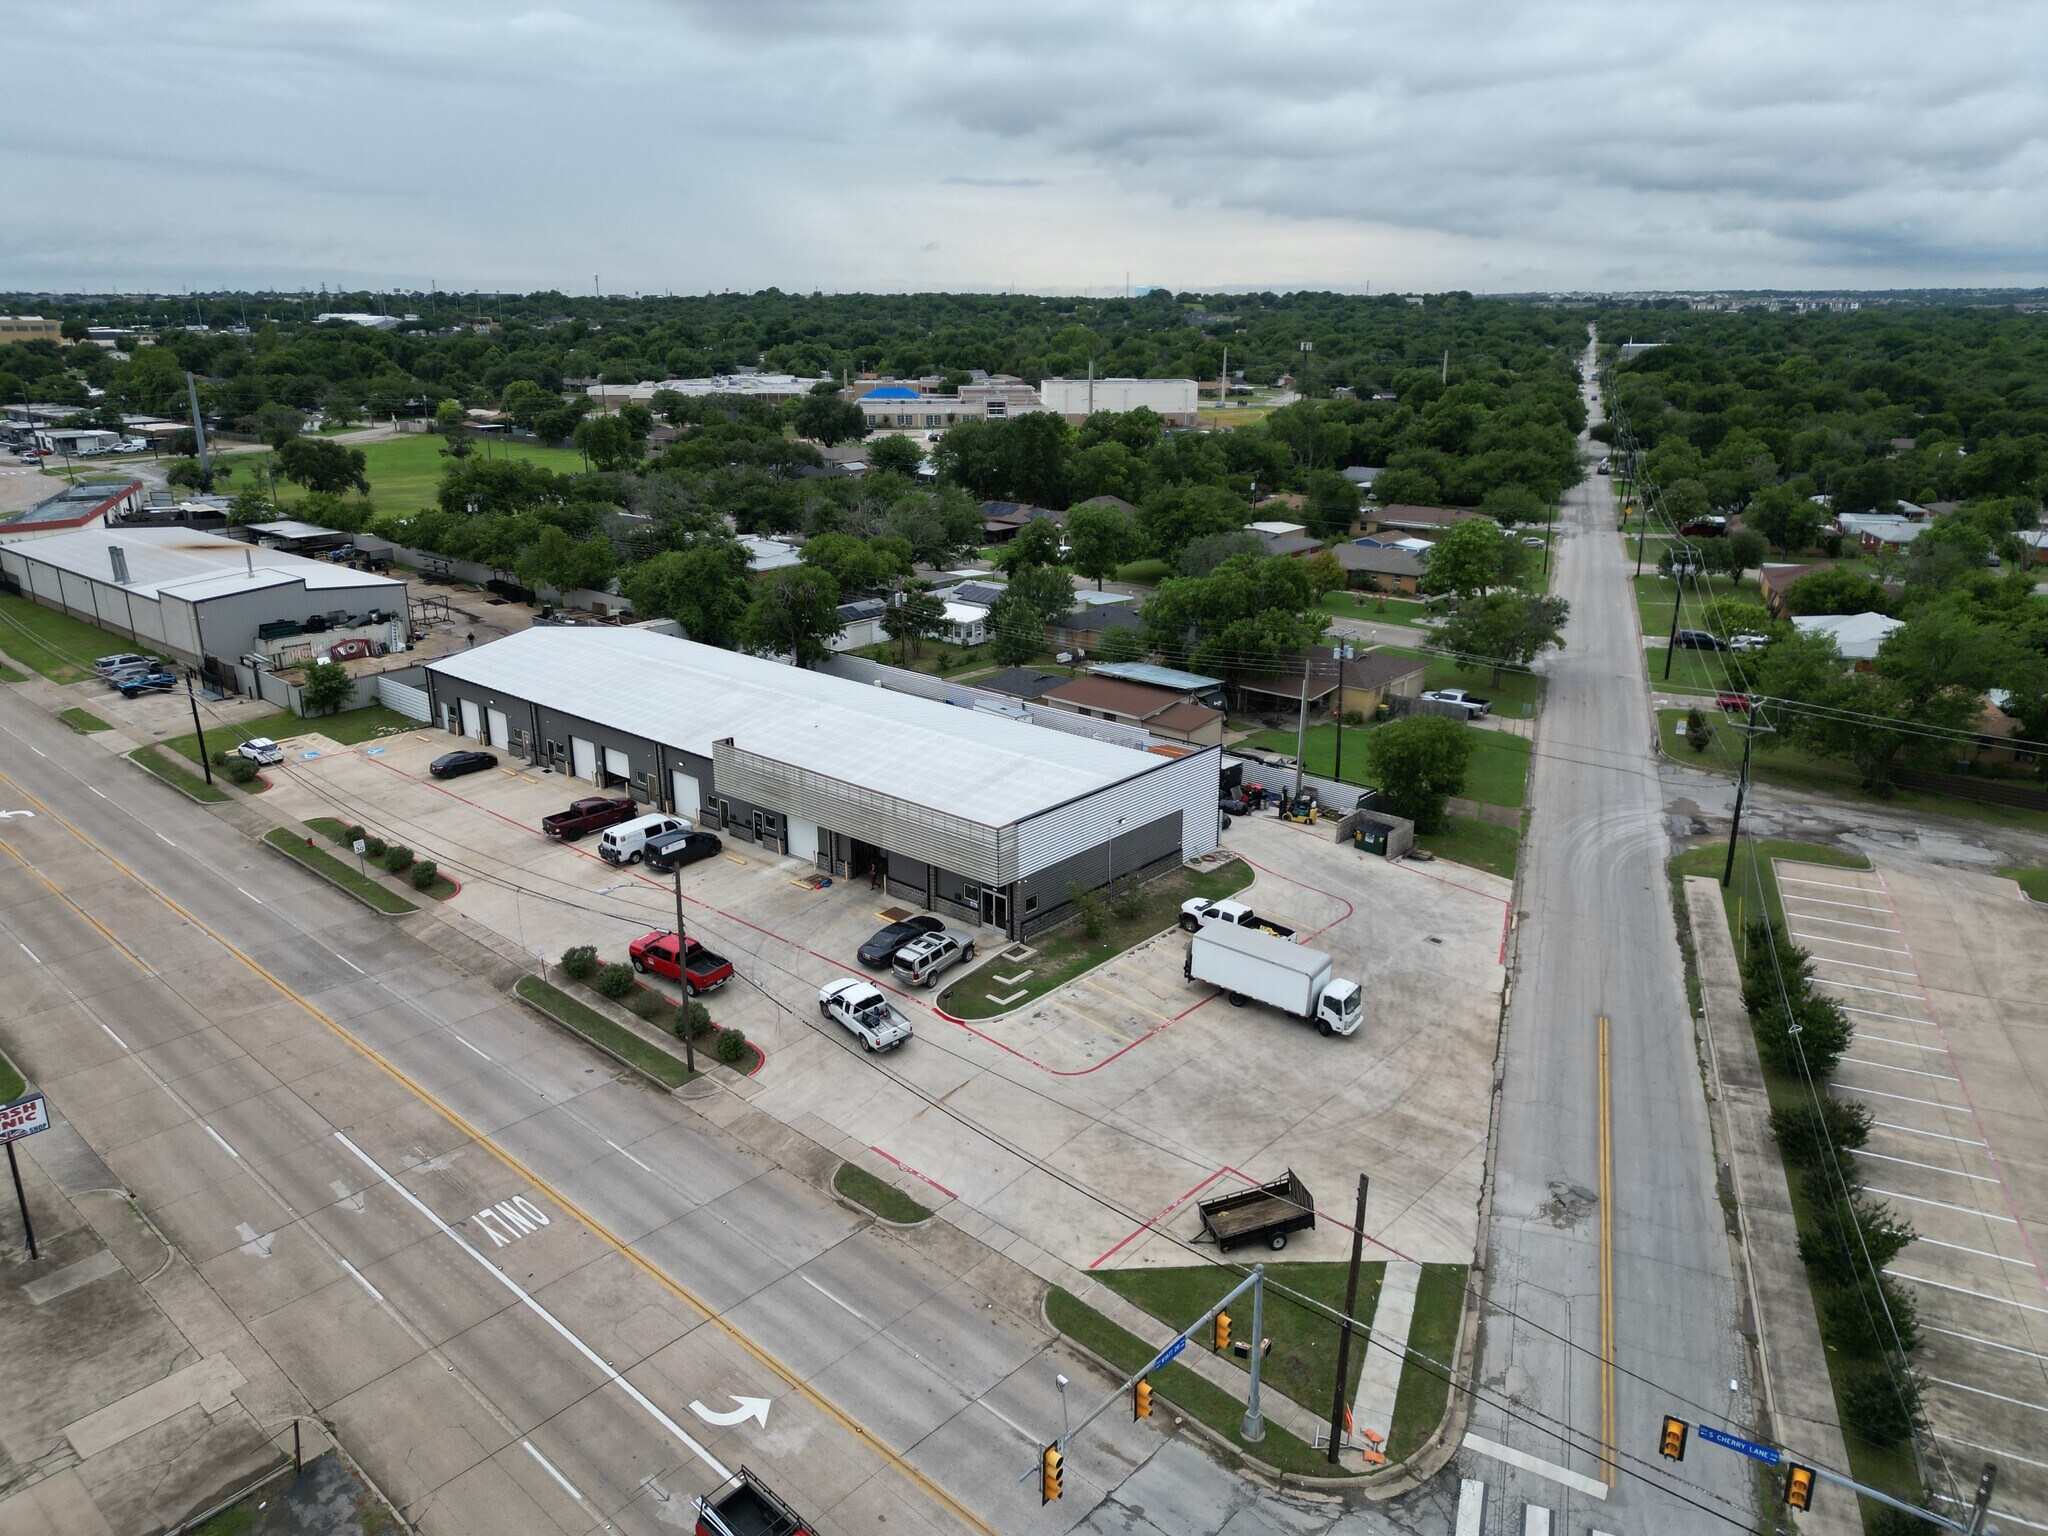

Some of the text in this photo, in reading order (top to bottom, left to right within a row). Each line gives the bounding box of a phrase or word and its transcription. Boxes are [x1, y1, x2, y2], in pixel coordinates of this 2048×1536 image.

[355, 845, 365, 853] 30
[29, 1122, 48, 1134] SHOP
[471, 1195, 550, 1248] ONLY
[1716, 1434, 1747, 1450] CHERRY
[1749, 1446, 1769, 1459] LANE
